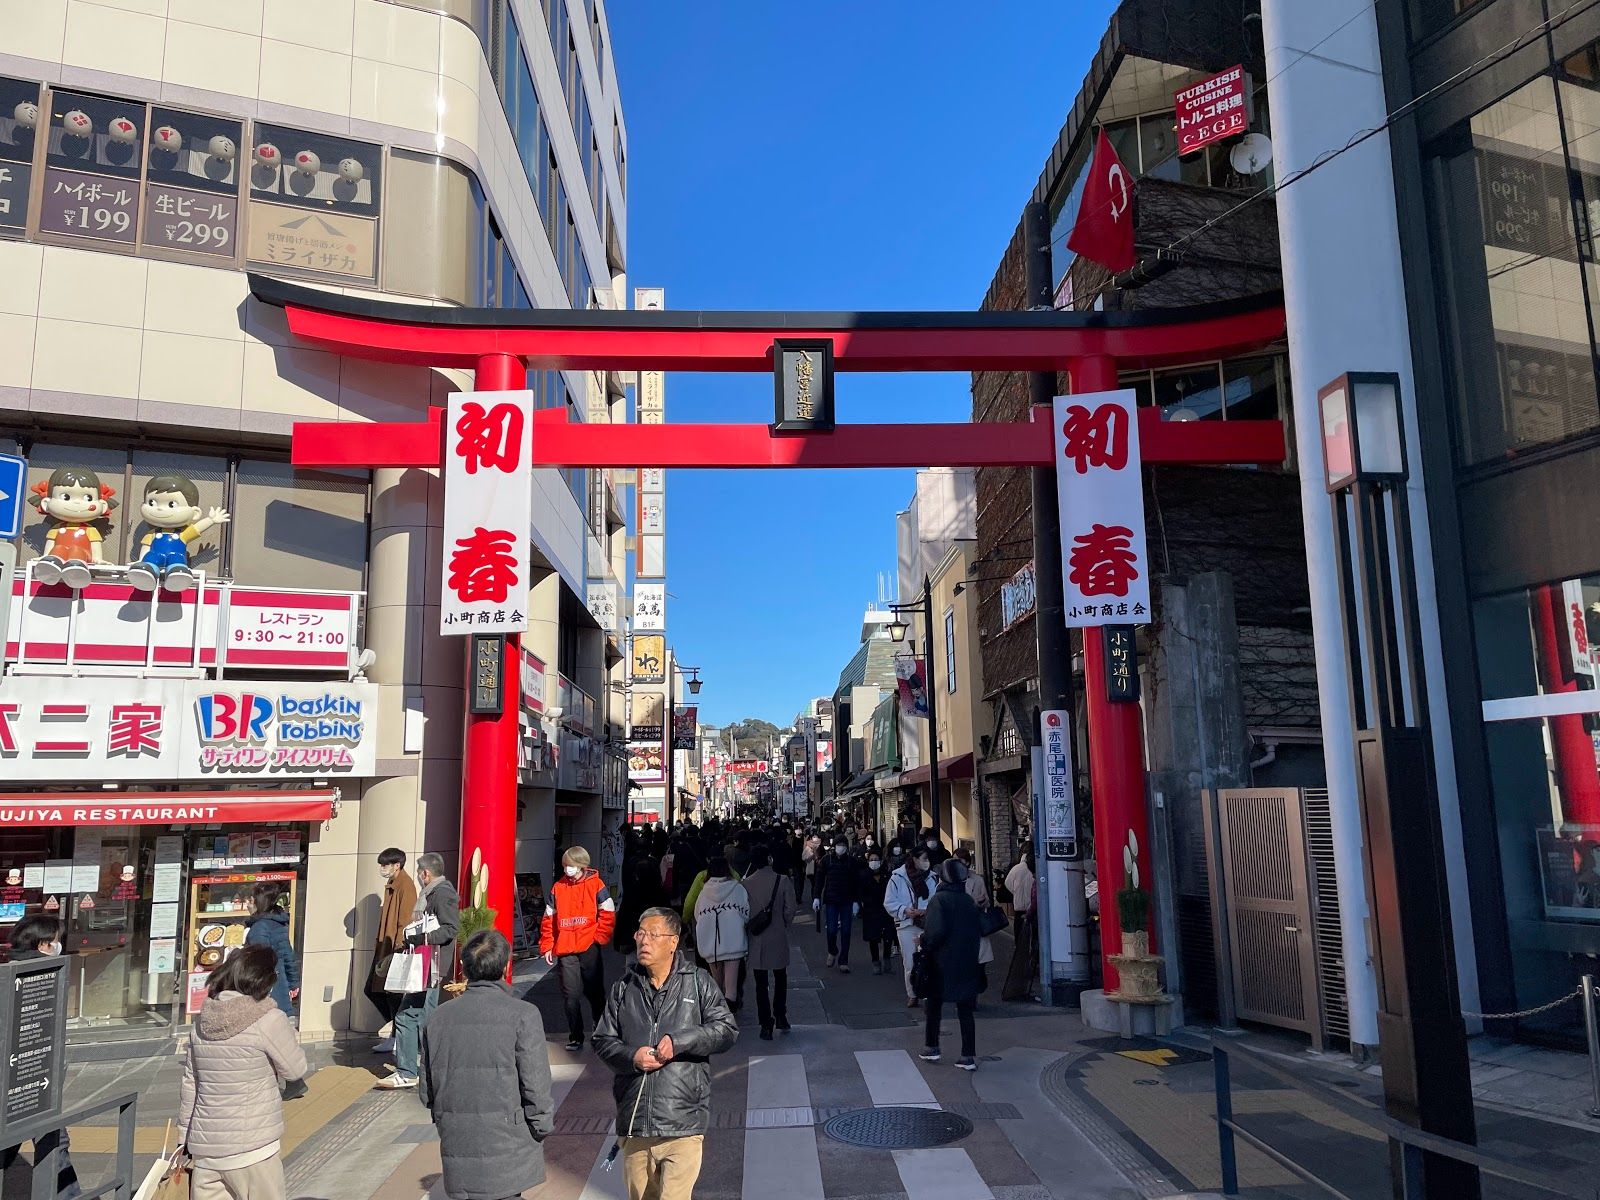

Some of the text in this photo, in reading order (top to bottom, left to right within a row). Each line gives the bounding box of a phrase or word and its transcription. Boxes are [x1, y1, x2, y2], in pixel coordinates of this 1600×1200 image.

[1177, 69, 1240, 103] TURKISH
[1185, 84, 1233, 110] CUISINE
[1180, 93, 1243, 129] トルコ料理
[1197, 113, 1242, 140] EGE
[53, 181, 132, 206] ハイボール
[154, 194, 230, 220] 生ビール
[267, 243, 355, 271] ミライザカ
[448, 402, 524, 603] 初春
[1063, 403, 1138, 597] 初春
[260, 612, 323, 626] レストラン
[444, 609, 524, 625] 小町商店会
[1069, 602, 1147, 618] 小町商店会
[479, 640, 499, 707] 小町通り
[1111, 632, 1131, 693] 小町通り
[200, 694, 273, 739] BR
[282, 694, 361, 715] baskin
[282, 721, 362, 740] robbins
[204, 748, 353, 764] サーティワン アイスクリーム
[73, 807, 218, 821] RESTAURANT
